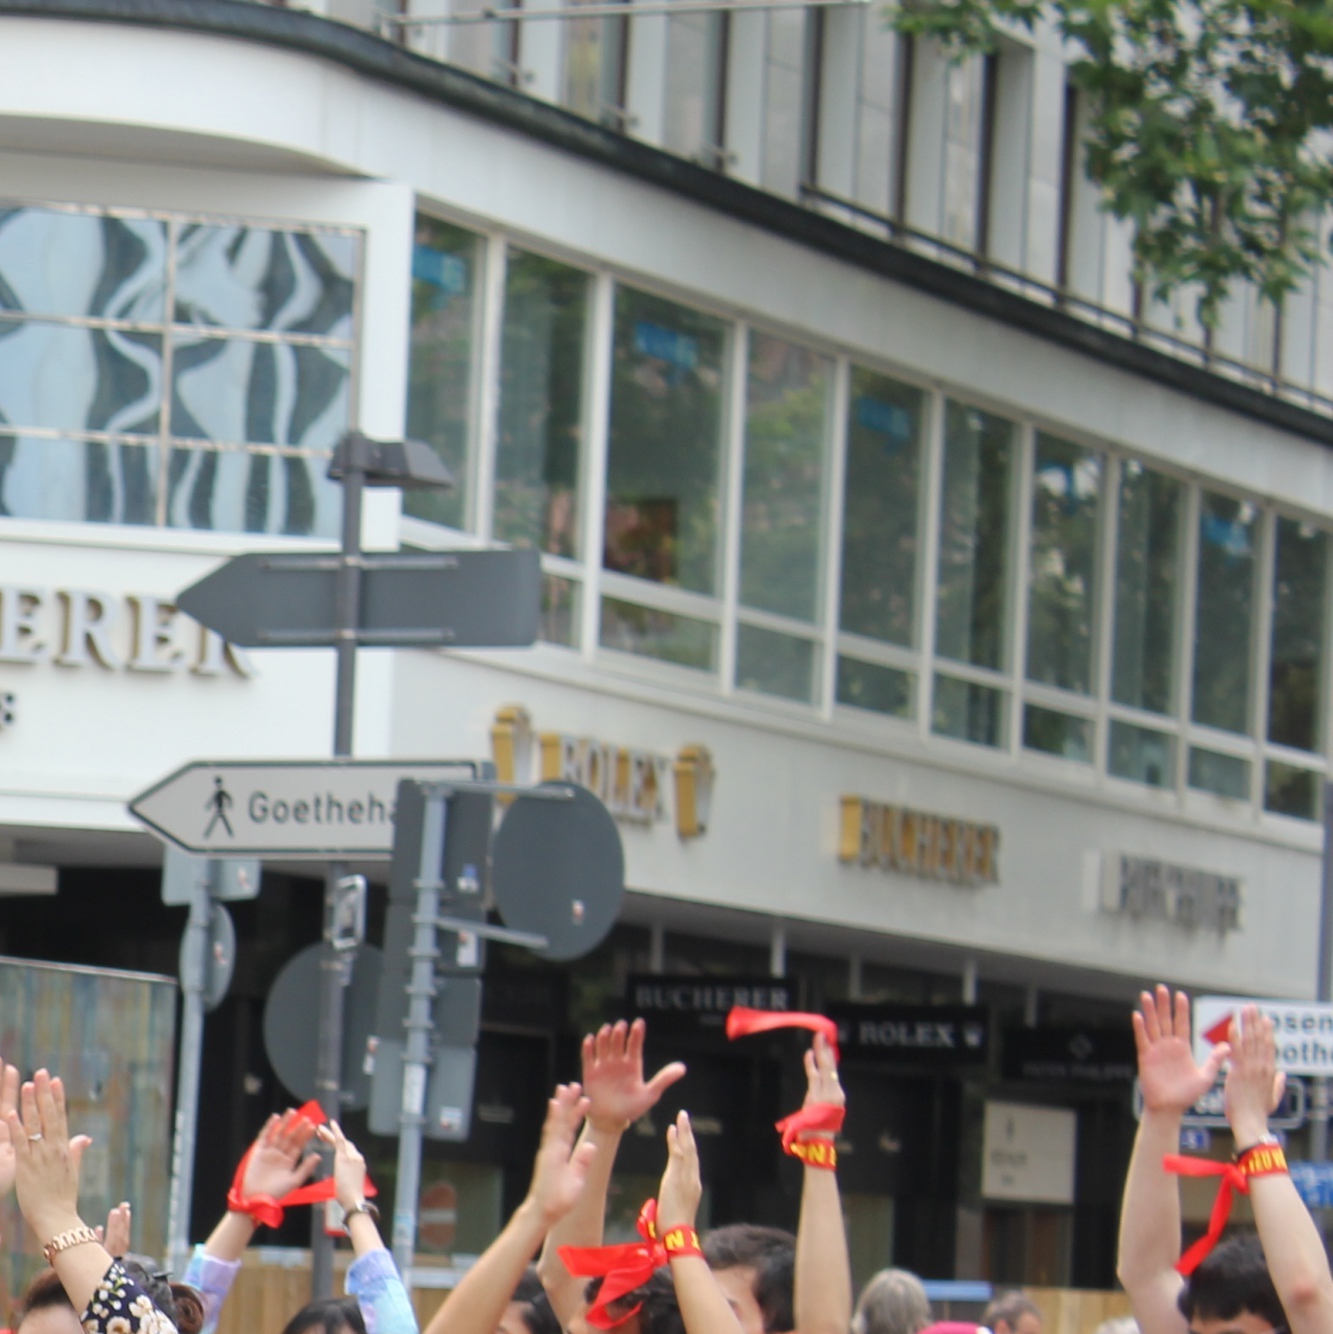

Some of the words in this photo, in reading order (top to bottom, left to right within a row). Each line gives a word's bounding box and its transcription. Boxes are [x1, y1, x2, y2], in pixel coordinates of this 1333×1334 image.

[635, 984, 789, 1012] BUCHERER
[858, 1021, 956, 1049] ROLEX
[1268, 1012, 1333, 1034] osen
[1275, 1042, 1333, 1066] oth
